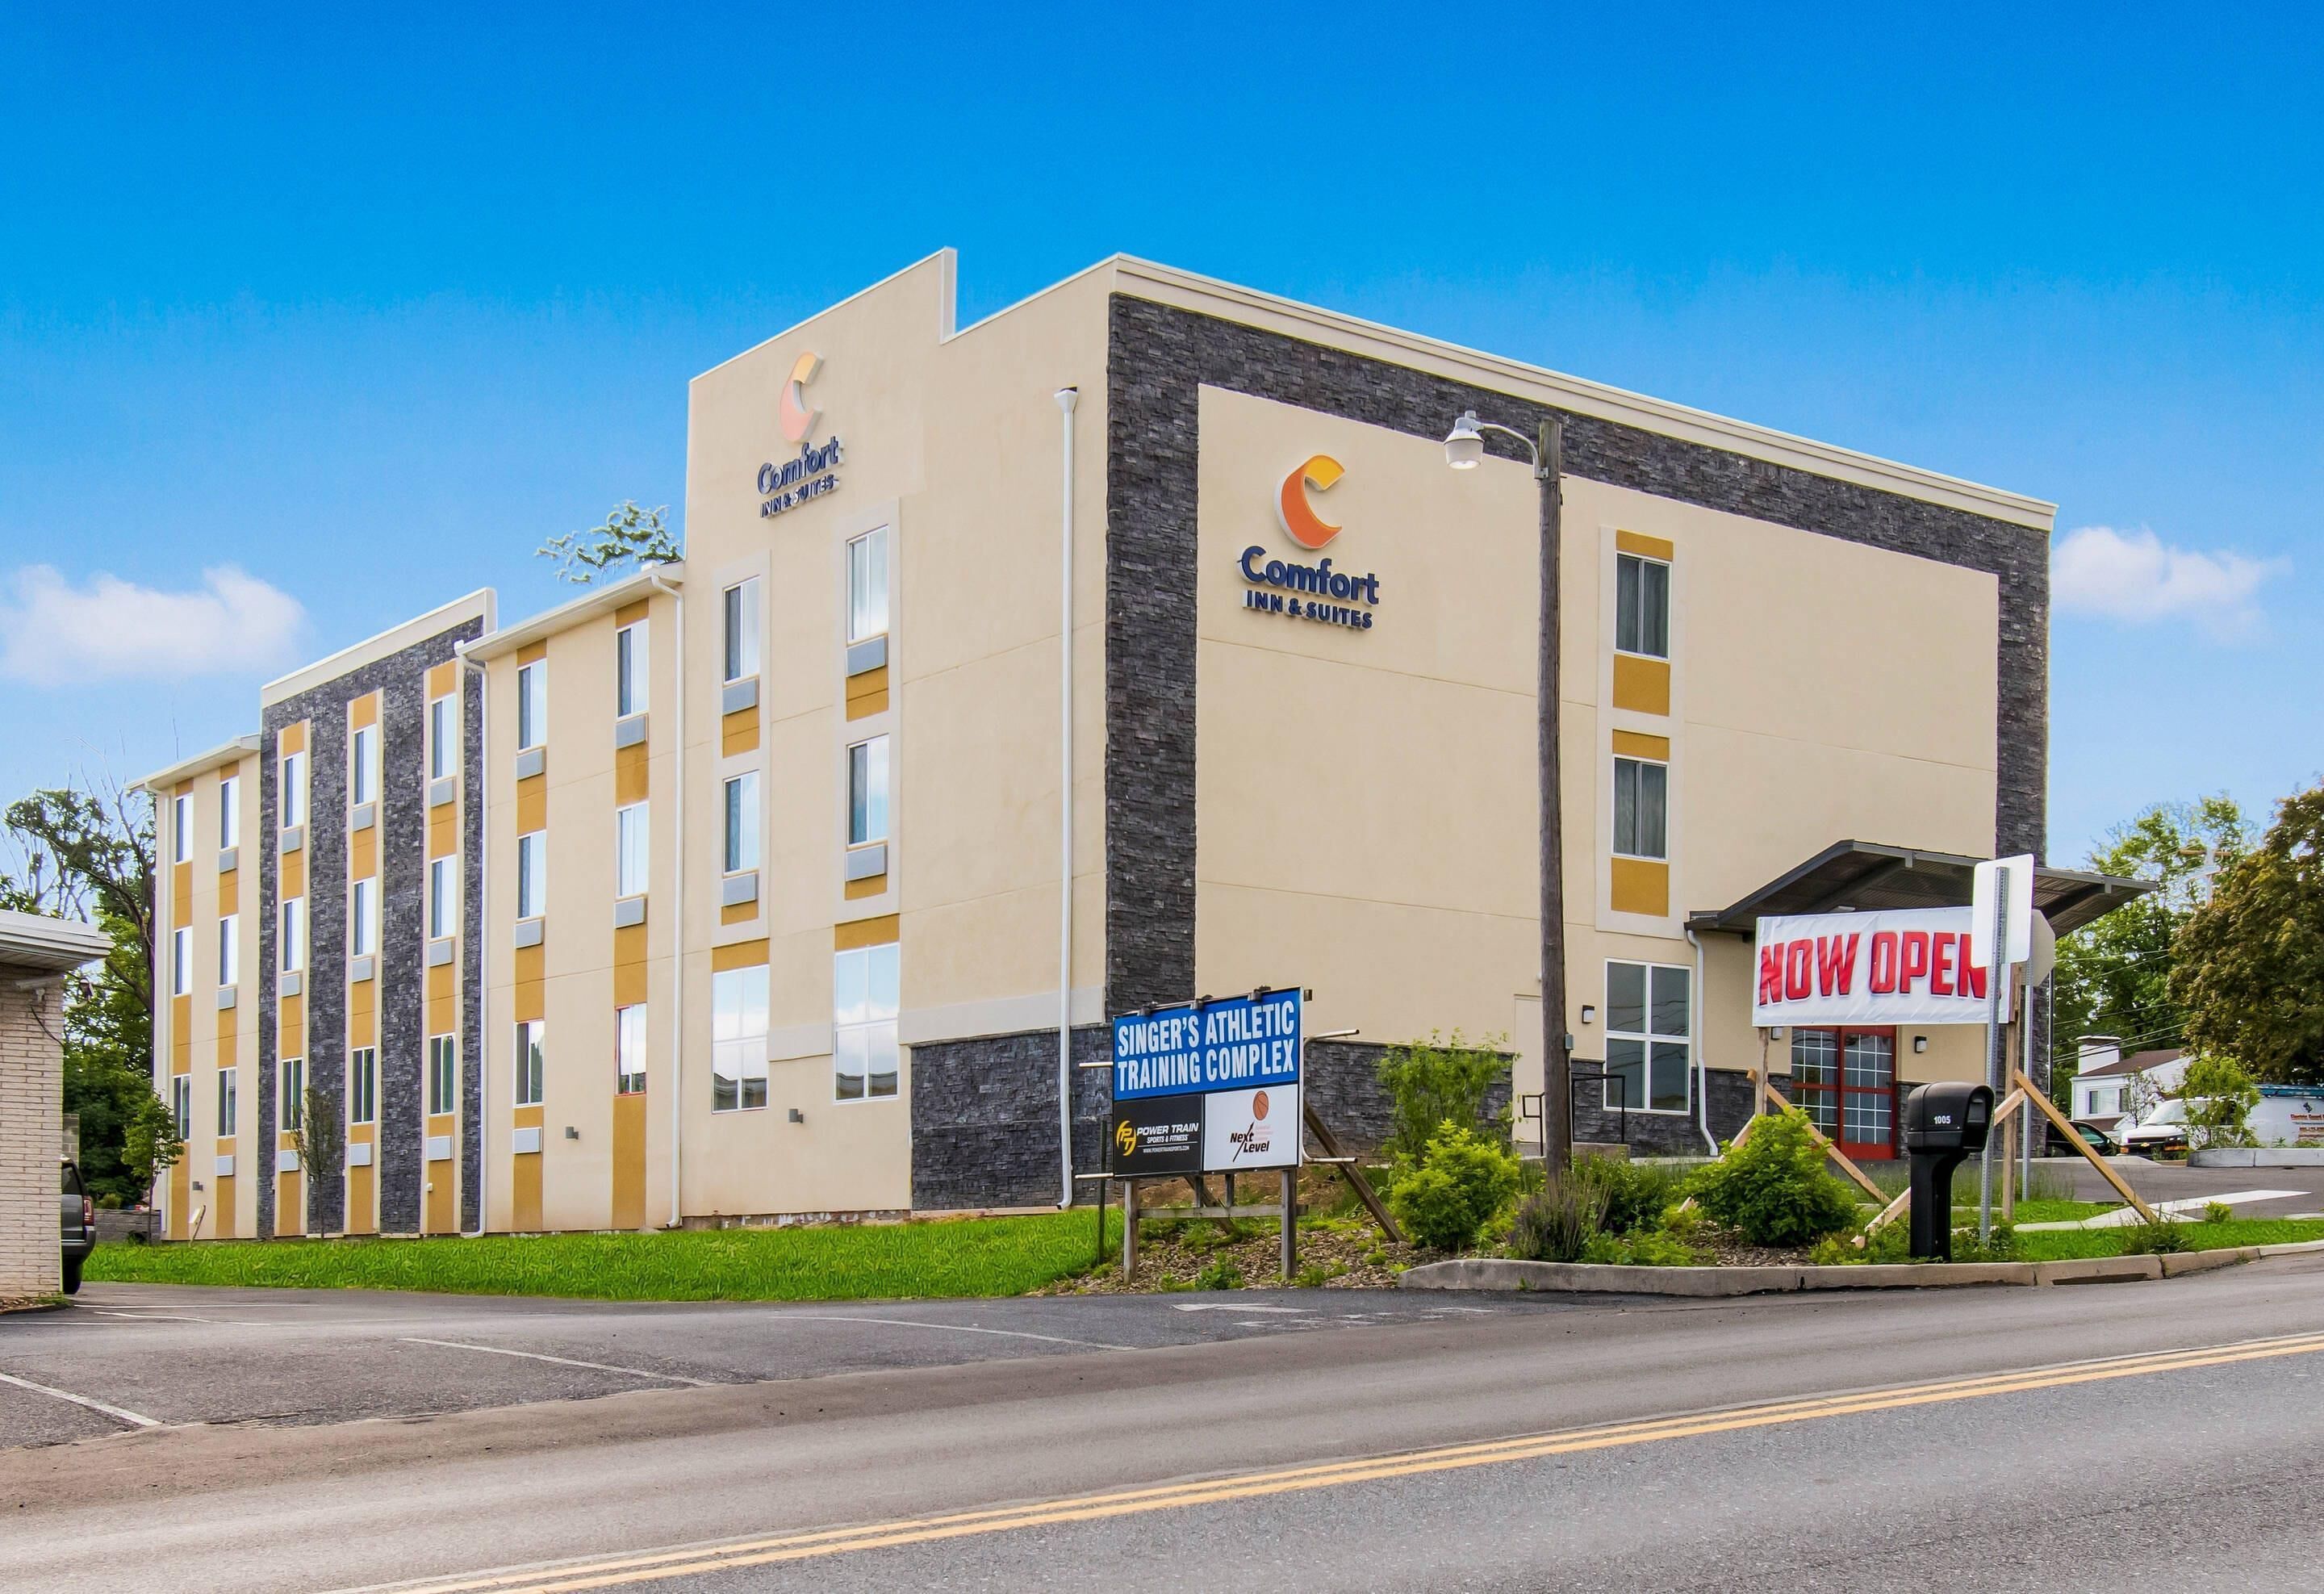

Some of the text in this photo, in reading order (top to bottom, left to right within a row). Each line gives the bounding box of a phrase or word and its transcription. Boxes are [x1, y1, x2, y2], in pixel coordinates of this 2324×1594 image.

[758, 436, 842, 495] Comfort
[760, 497, 782, 518] INN
[792, 474, 836, 504] SUITES
[1238, 545, 1379, 605] Comfort
[1244, 589, 1373, 630] INN & SUITES
[1758, 931, 1860, 1006] NOW
[1118, 1000, 1294, 1057] SINGER'S ATHLETIC
[1118, 1038, 1294, 1092] TRAINING COMPLEX
[1136, 1123, 1199, 1136] POWER TRAIN
[1147, 1135, 1164, 1144] SPORTS
[1230, 1132, 1254, 1143] Next
[1933, 1115, 1951, 1124] 1005
[1244, 1140, 1269, 1153] Level
